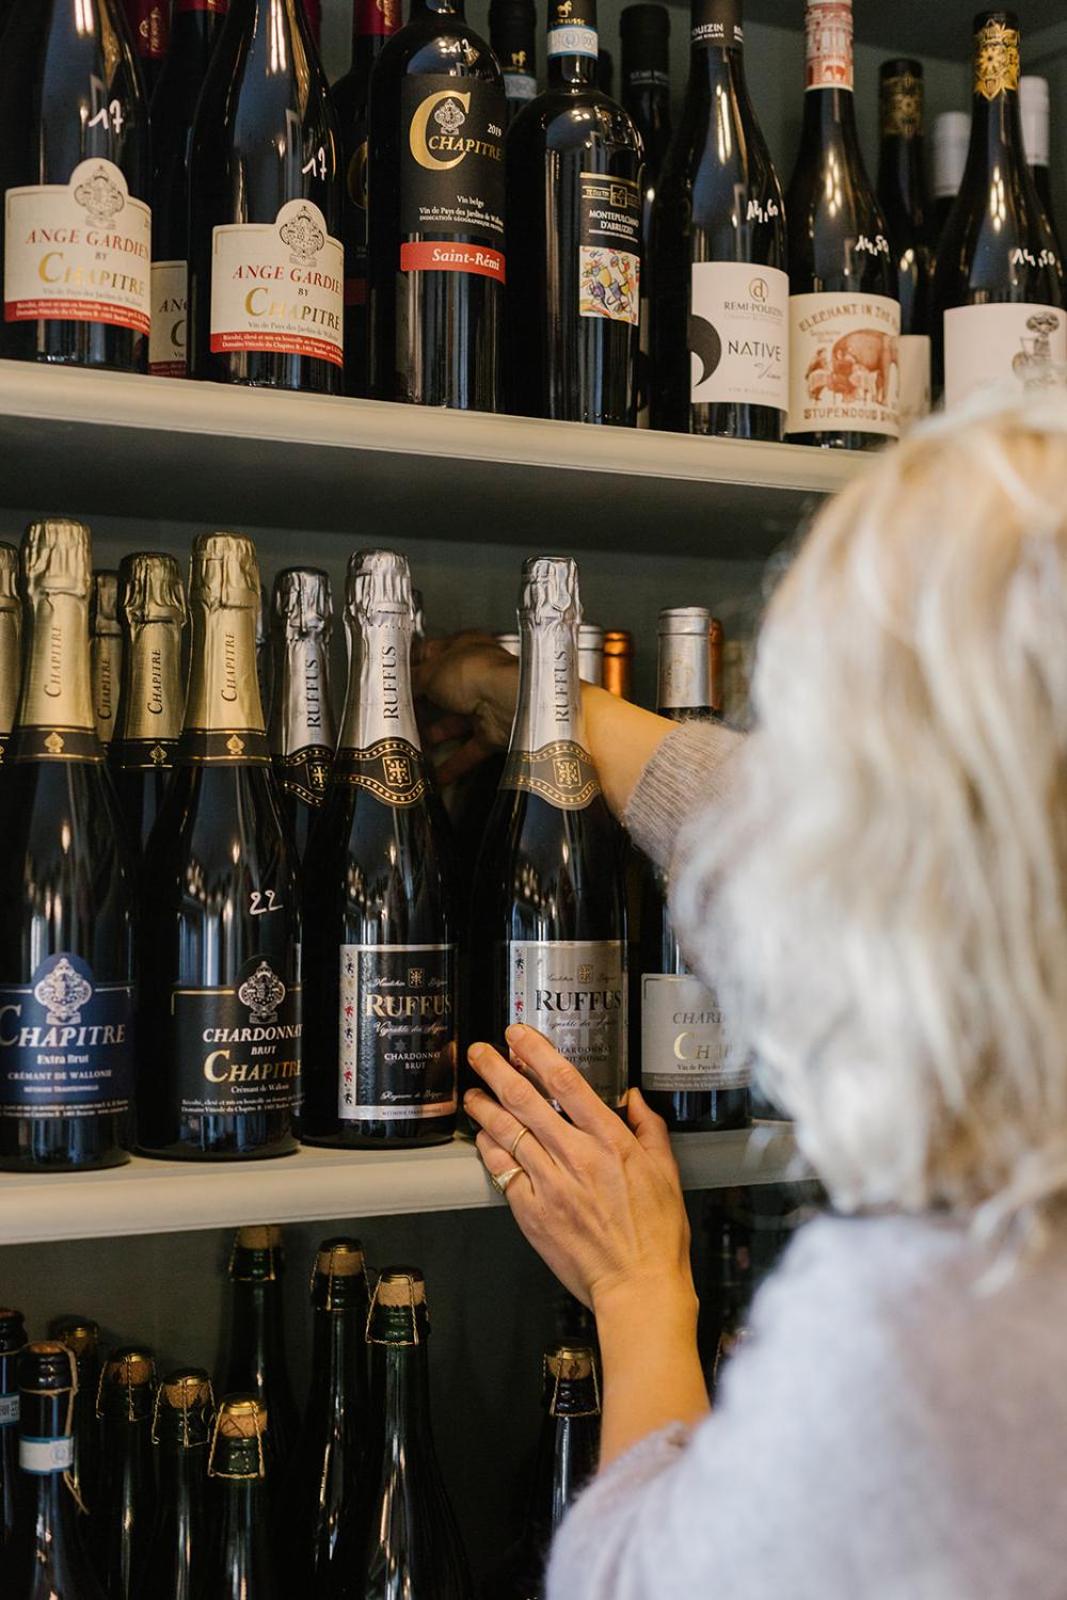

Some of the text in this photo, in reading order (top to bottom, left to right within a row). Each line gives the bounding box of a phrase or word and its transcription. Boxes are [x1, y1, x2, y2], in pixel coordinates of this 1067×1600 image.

[88, 99, 124, 134] 17
[487, 123, 502, 137] 2019
[428, 136, 502, 160] CHAPITRE
[302, 146, 327, 181] 17
[419, 207, 431, 215] Vin
[432, 206, 439, 215] de
[440, 208, 455, 217] Pays
[456, 208, 465, 216] des
[457, 195, 468, 204] Vin
[26, 229, 80, 244] ANGE
[431, 247, 500, 271] Saint-Rémi
[1012, 248, 1055, 268] 14,50
[38, 251, 145, 296] CHAPITRE
[233, 264, 285, 280] ANGE
[244, 287, 340, 331] CHAPITRE
[728, 340, 782, 362] NATIVE
[43, 626, 62, 698] CHAPITRE
[220, 632, 238, 702] CHAPITRE
[146, 649, 163, 714] CHAPITRE
[305, 658, 321, 728] RUFFUS
[382, 645, 399, 720] RUFFUS
[554, 650, 570, 722] RUFFUS
[249, 889, 284, 915] 22
[365, 993, 452, 1018] RUFFUS
[535, 990, 622, 1012] RUFFUS
[37, 1054, 89, 1065] Extra Brut
[251, 1046, 276, 1056] BRUT
[203, 1049, 302, 1083] CHAPITRE
[405, 1062, 425, 1070] BRUT
